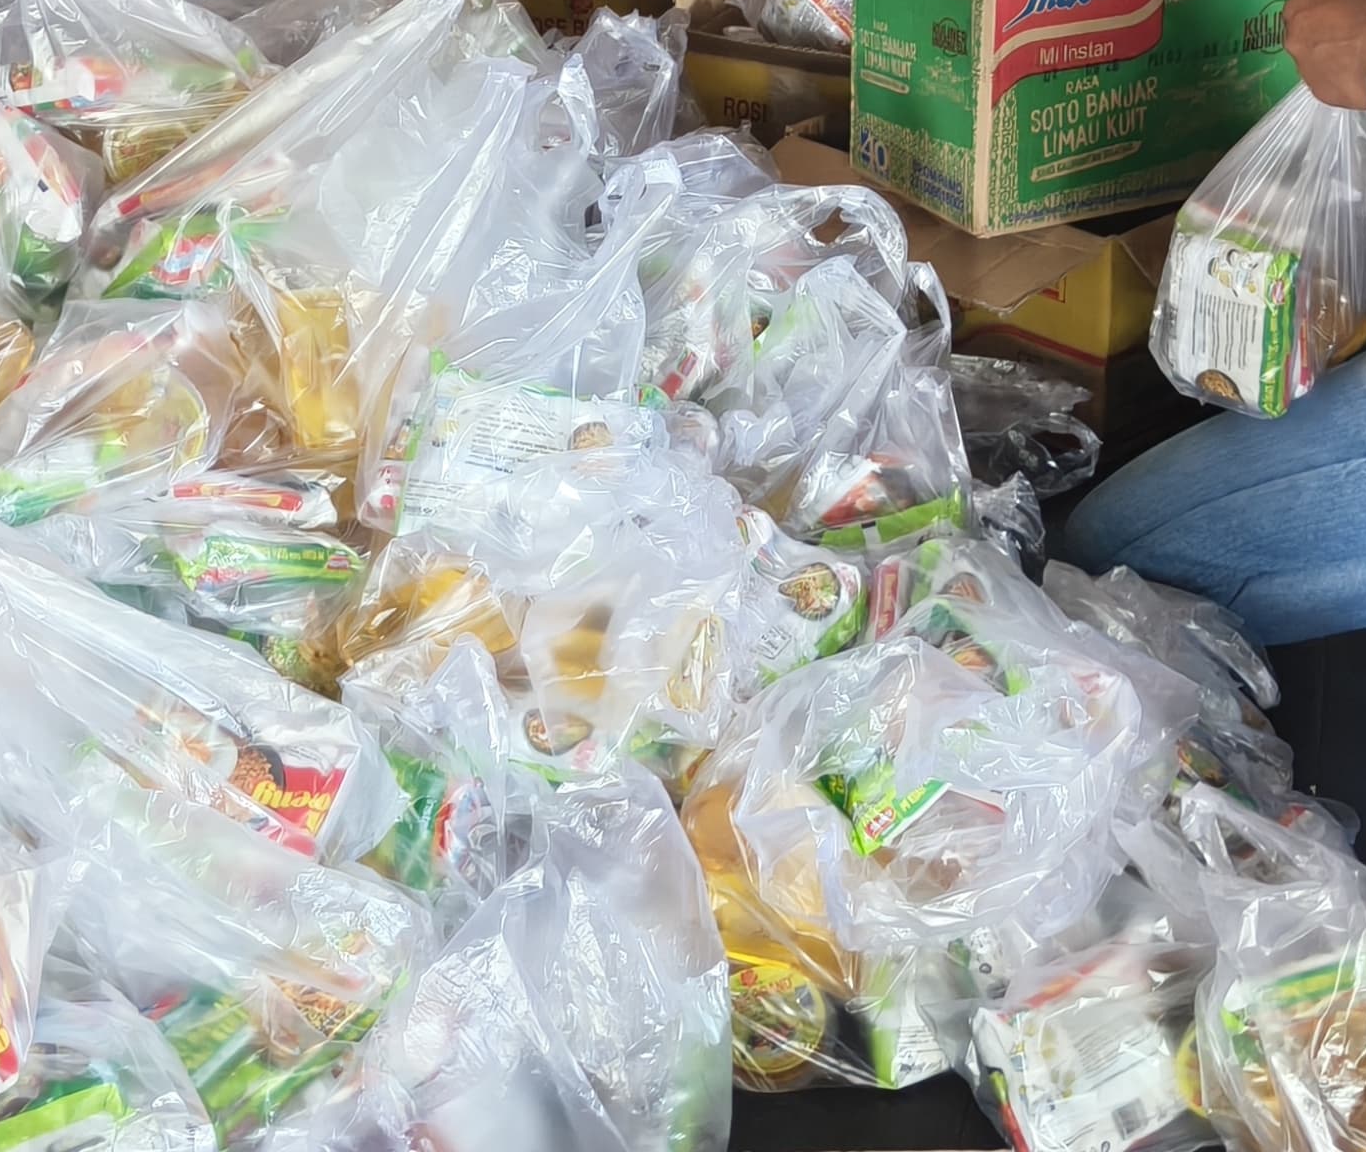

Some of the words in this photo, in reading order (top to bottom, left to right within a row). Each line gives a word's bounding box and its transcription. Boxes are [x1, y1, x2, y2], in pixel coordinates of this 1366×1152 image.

[1063, 40, 1114, 62] Instan
[1065, 74, 1101, 95] RASA
[1030, 99, 1080, 134] SOTO
[1085, 76, 1159, 118] BANJAR
[1042, 119, 1101, 159] LIMAU
[1106, 105, 1148, 140] KUIT
